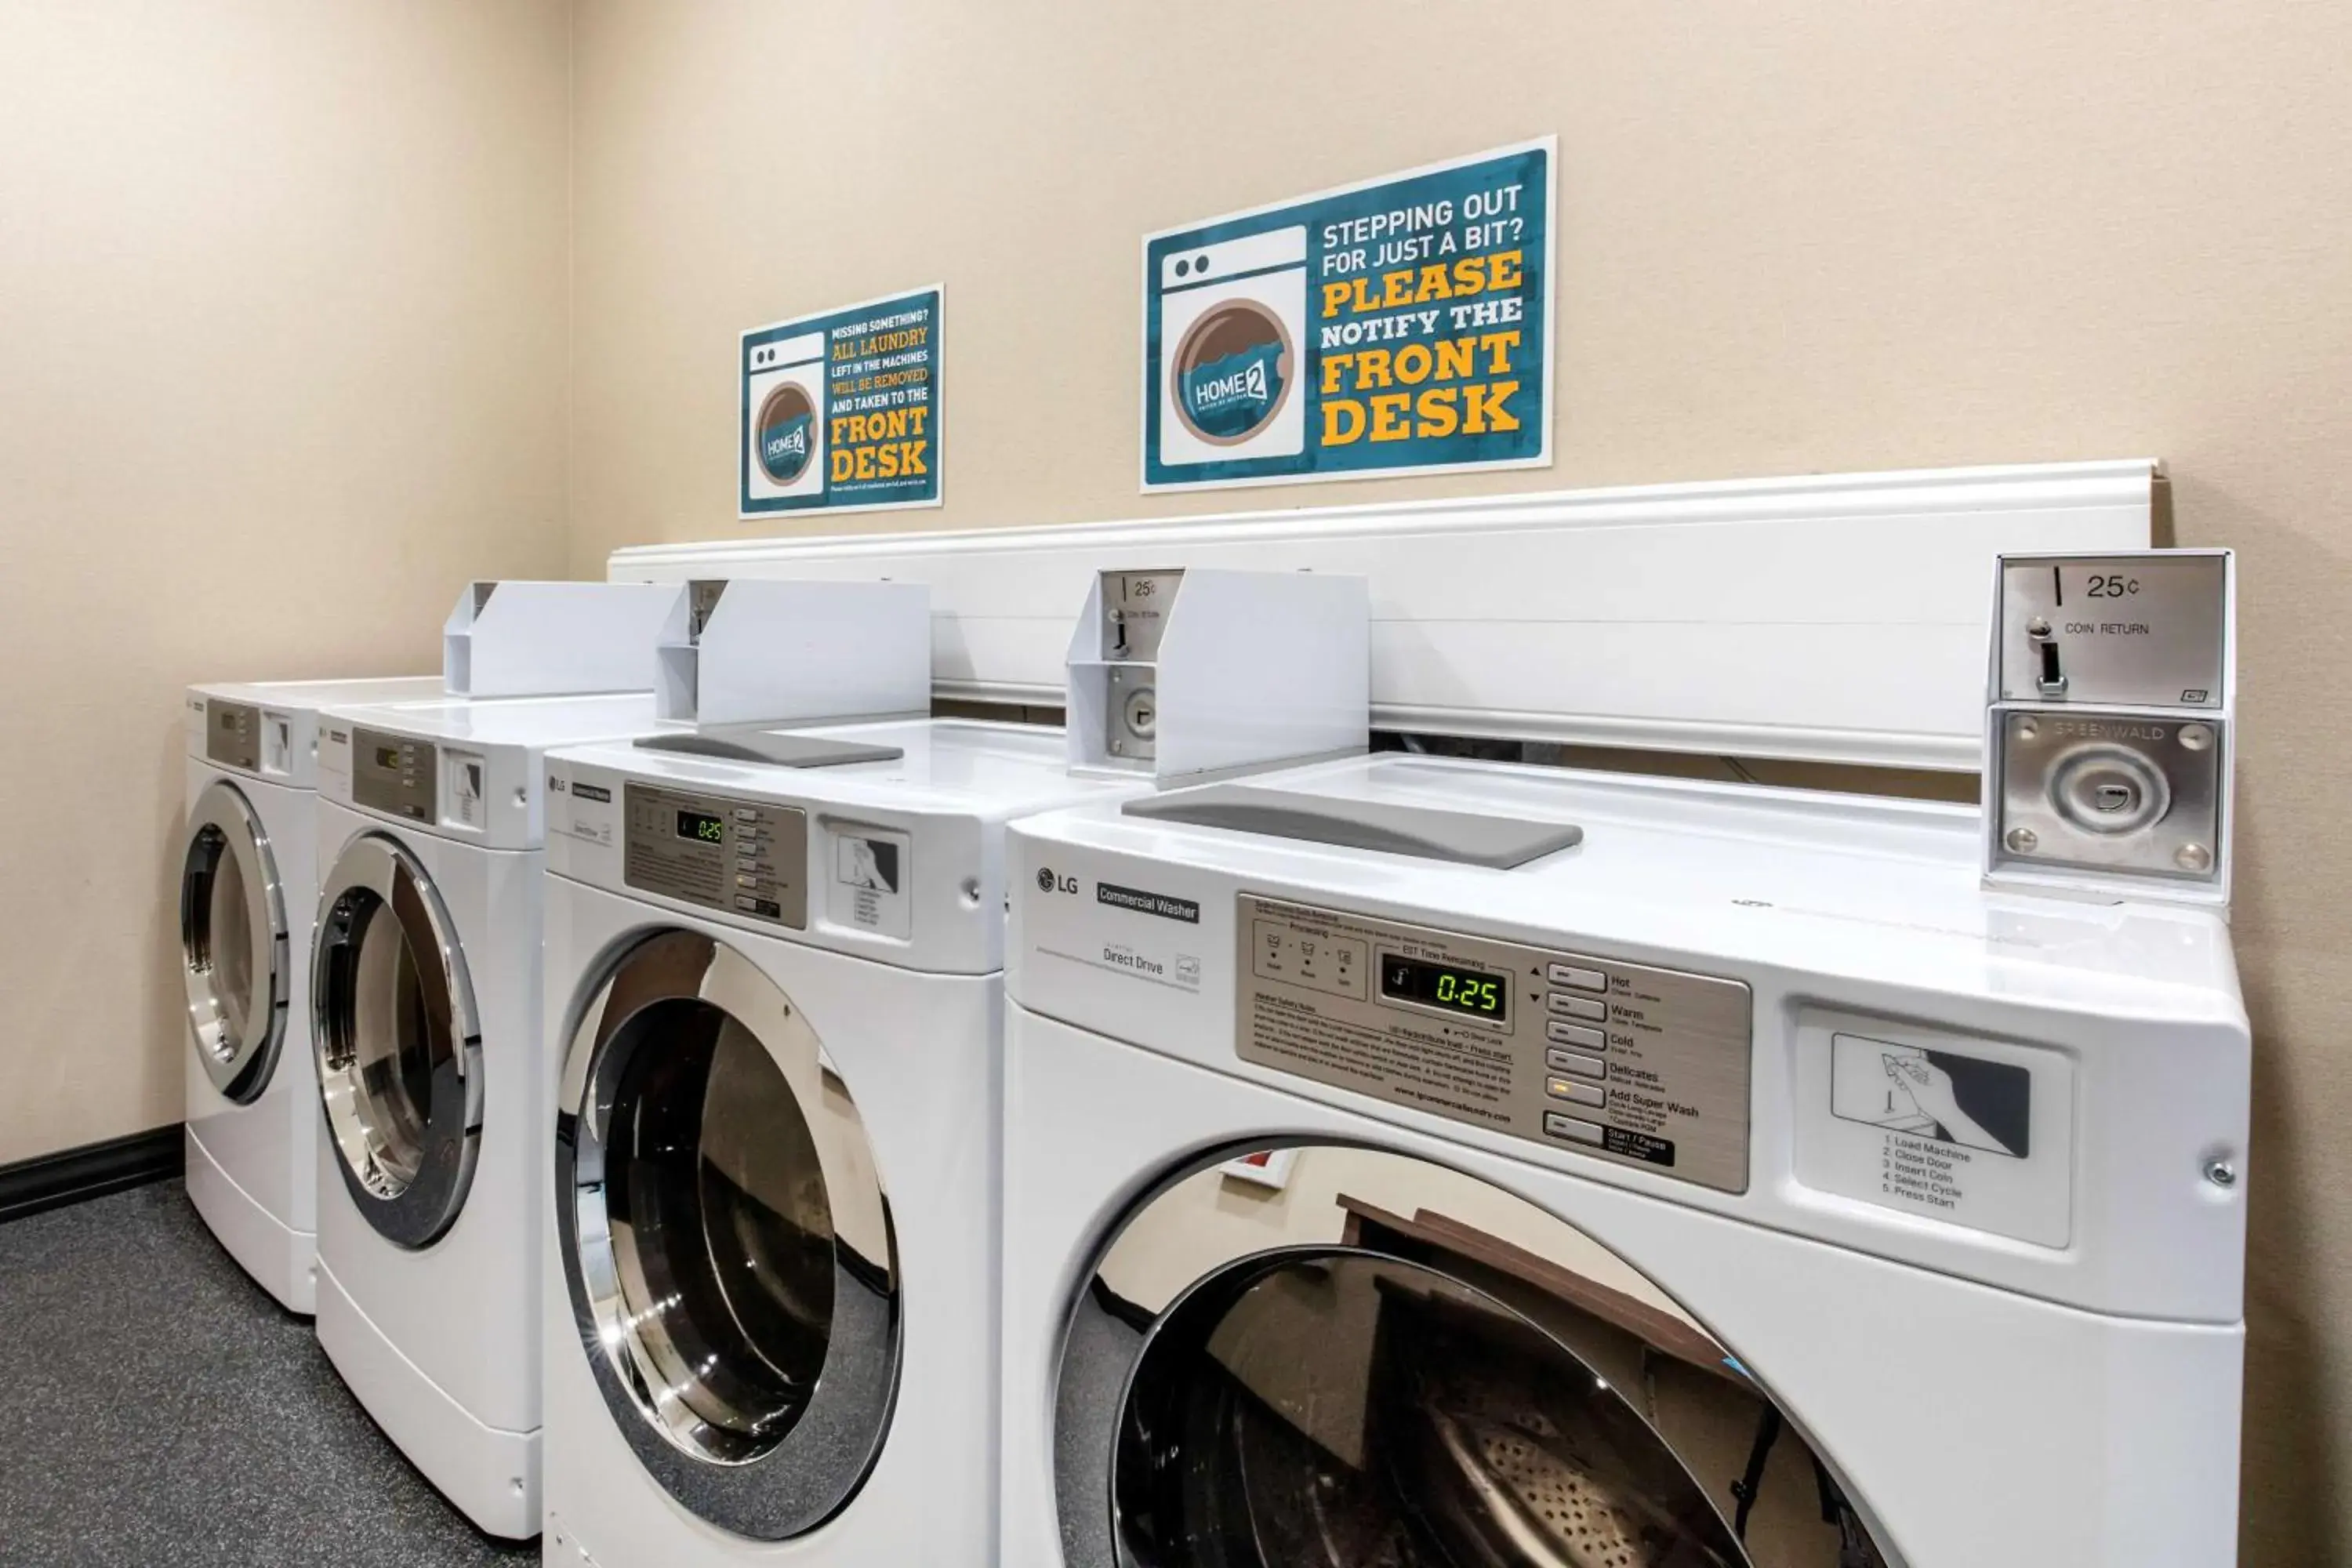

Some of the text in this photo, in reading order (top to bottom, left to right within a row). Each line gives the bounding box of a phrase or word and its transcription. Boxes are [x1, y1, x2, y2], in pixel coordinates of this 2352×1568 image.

[1323, 184, 1522, 249] STEPPING OUT
[1323, 217, 1523, 276] FOR JUST A BIT?
[1322, 249, 1522, 318] PLEASE
[832, 309, 928, 339] MISSING SOMETHING?
[1322, 297, 1522, 349] NOTIFY THE
[833, 326, 928, 361] ALL LAUNDRY
[832, 350, 928, 377] LEFT IN THE MACHINES
[1322, 331, 1520, 394] FRONT
[833, 368, 927, 395] WILL BE REMOVED
[832, 387, 928, 414] AND TAKEN TO THE
[1322, 381, 1520, 447] DESK
[831, 406, 927, 445] FRONT
[831, 441, 927, 482] DESK
[2065, 622, 2150, 636] COIN RETURN
[2055, 721, 2165, 740] GREENWALD
[1058, 874, 1196, 919] LG Commercial Washer
[1104, 947, 1163, 975] Direct Drive
[1421, 948, 1440, 960] Time
[1442, 953, 1486, 970] Remaining
[1437, 975, 1497, 1011] 0.25
[1611, 976, 1630, 987] Hot
[1612, 1004, 1644, 1019] Warm
[1611, 1035, 1634, 1047] Cold
[1610, 1063, 1658, 1082] Delicates
[1610, 1089, 1631, 1102] Add
[1633, 1094, 1664, 1109] Super
[1667, 1102, 1699, 1118] Wash
[1609, 1129, 1630, 1140] Start
[1639, 1136, 1666, 1150] Pause
[1895, 1136, 1921, 1151] Load
[1923, 1143, 1971, 1163] Machine
[1895, 1149, 1925, 1164] Close
[1926, 1156, 1952, 1170] Door
[1895, 1161, 1926, 1176] Insert
[1929, 1170, 1953, 1184] Coin
[1894, 1174, 1928, 1190] Select
[1932, 1182, 1962, 1199] Cycle
[1894, 1185, 1925, 1201] Press
[1927, 1194, 1955, 1210] Start
